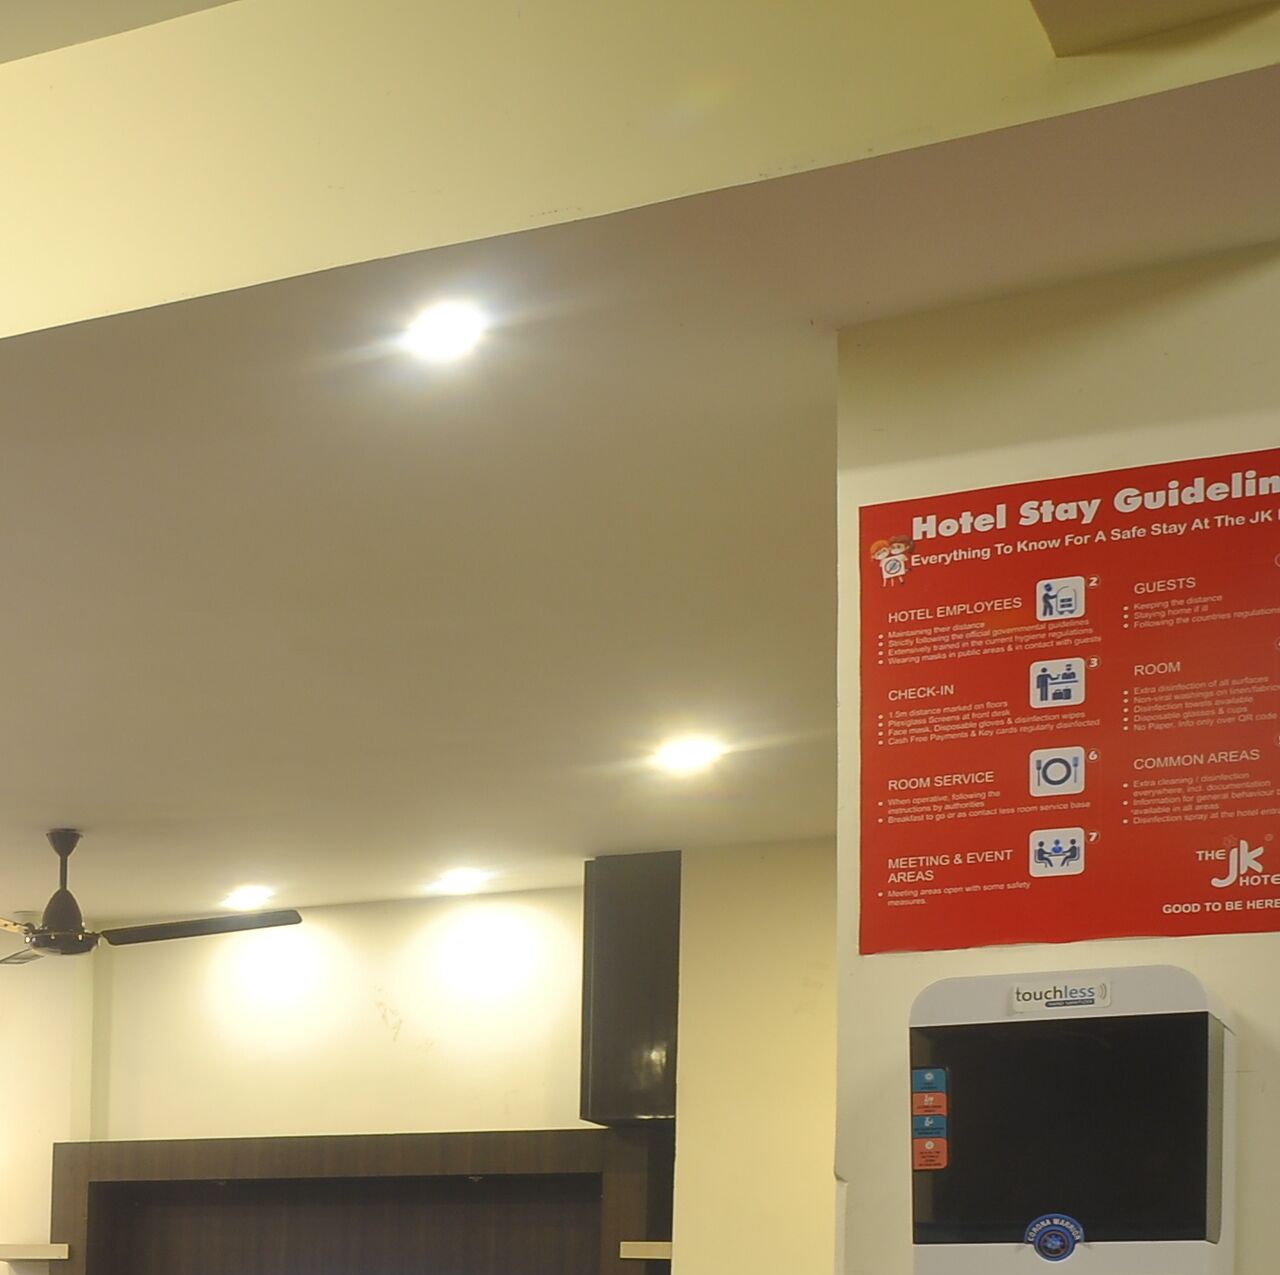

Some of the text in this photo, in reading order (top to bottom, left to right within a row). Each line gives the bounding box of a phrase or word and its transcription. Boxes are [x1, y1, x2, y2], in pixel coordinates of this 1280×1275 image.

[912, 504, 1007, 541] Hotel
[1018, 499, 1101, 527] Stay
[911, 510, 1272, 566] Everything To Know For A Safe Stay At The JK
[1089, 577, 1099, 587] 2
[1134, 577, 1196, 594] GUESTS
[888, 596, 1022, 624] HOTEL EMPLOYEES
[1089, 657, 1099, 668] 3
[1134, 661, 1181, 676] ROOM
[888, 684, 954, 702] CHECK-IN
[1089, 751, 1098, 761] 6
[1133, 748, 1260, 770] COMMON AREAS
[888, 770, 995, 791] ROOM SERVICE
[1089, 832, 1098, 842] 7
[888, 849, 1013, 869] MEETING & EVENT
[1195, 849, 1226, 861] THE
[888, 870, 934, 884] AREAS
[1162, 898, 1280, 914] GOOD TO BE HERE
[1015, 985, 1095, 1001] touchless
[1027, 1219, 1051, 1241] CORONA
